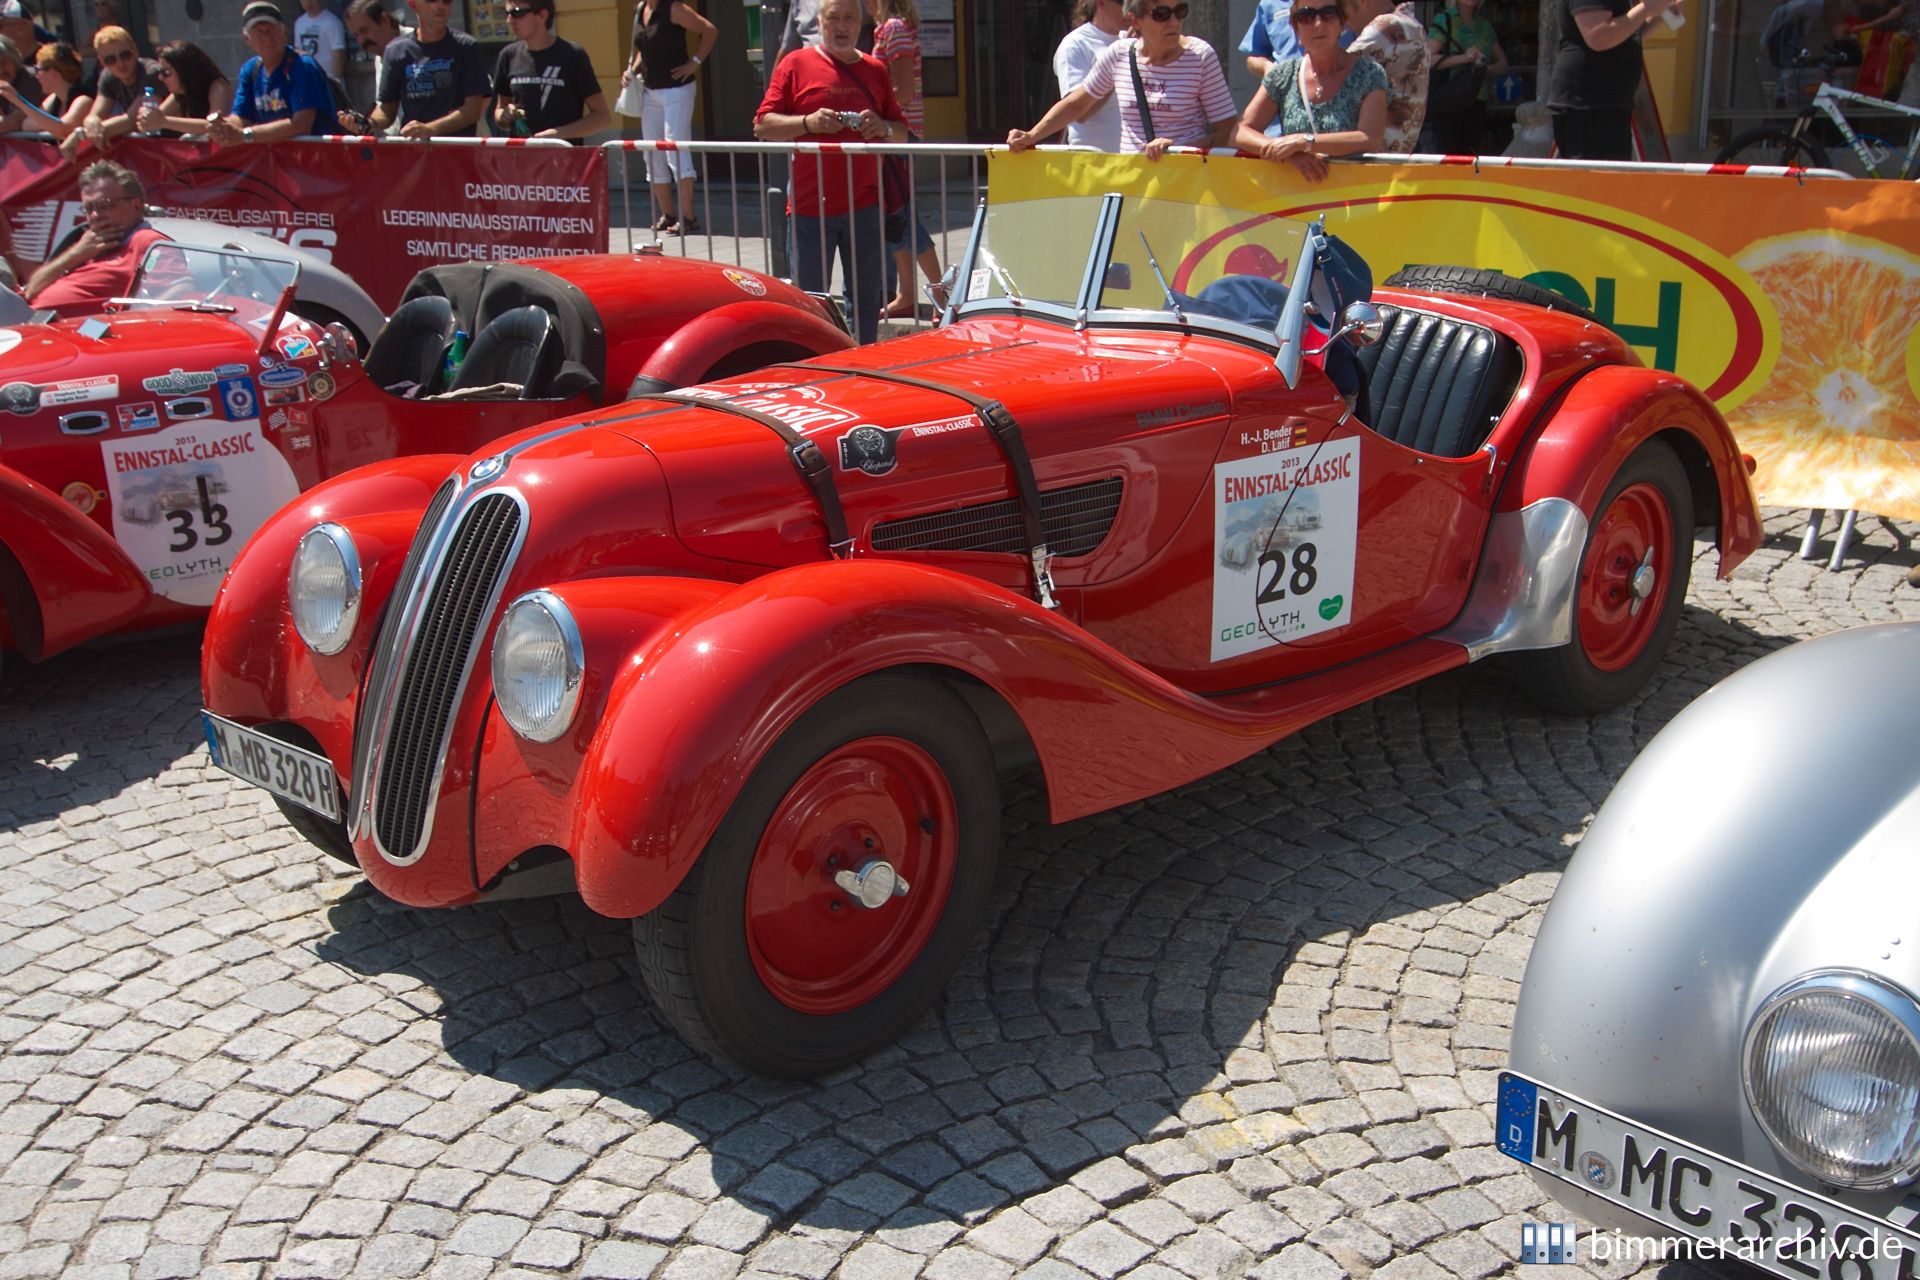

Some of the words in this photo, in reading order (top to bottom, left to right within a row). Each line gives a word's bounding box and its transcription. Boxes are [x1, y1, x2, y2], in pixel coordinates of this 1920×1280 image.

[464, 182, 591, 203] CABRIOVERDECKE
[166, 206, 335, 227] FAHRZEUGSATTLEREI
[382, 209, 594, 234] LEDERINNENAUSSTATTUNGEN
[406, 239, 487, 260] SÄMTLICHE
[1136, 409, 1175, 428] BMW
[1177, 401, 1226, 421] Classic
[912, 417, 975, 437] ENNSTAL-CLASSIC
[1241, 430, 1263, 445] H.-J.
[1263, 426, 1293, 441] Bender
[175, 435, 197, 446] 2013
[1261, 441, 1271, 454] D.
[1272, 438, 1291, 452] Latif
[113, 432, 255, 473] ENNSTAL-CLASSIC
[1281, 457, 1300, 470] 2013
[1224, 452, 1352, 504] ENNSTAL-CLASSIC
[147, 556, 222, 580] EOLYTH
[1257, 542, 1318, 605] 28
[1221, 610, 1301, 642] GEOLYTH
[213, 724, 233, 768] M
[238, 733, 271, 784] MB
[1509, 1125, 1522, 1144] D
[1535, 1096, 1579, 1173] M
[1620, 1133, 1713, 1227] MC
